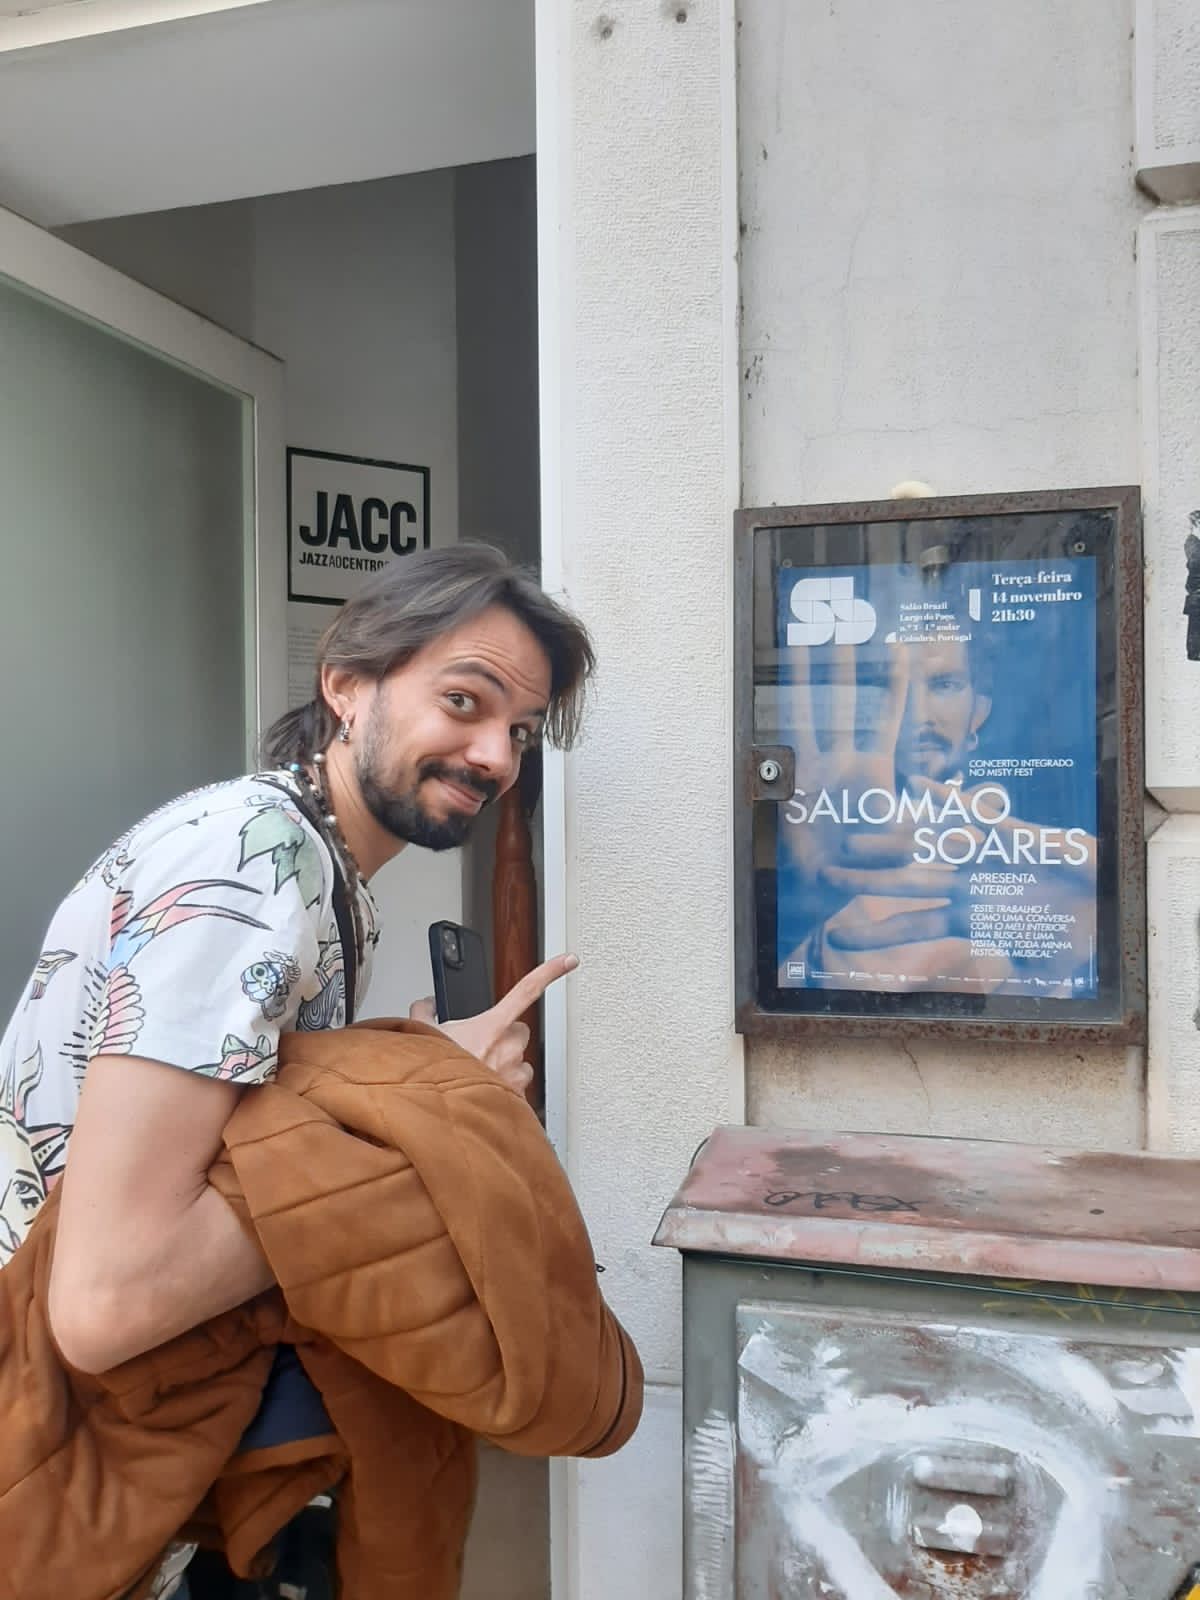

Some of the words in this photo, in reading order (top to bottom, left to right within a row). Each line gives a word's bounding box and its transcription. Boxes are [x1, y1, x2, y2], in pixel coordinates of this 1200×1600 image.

[299, 491, 416, 555] JACC
[992, 571, 1072, 587] Terça-feira
[992, 591, 1008, 604] 14
[1010, 588, 1083, 603] novembro
[991, 608, 1036, 622] 21h30
[968, 759, 1019, 768] CONCERTO
[1020, 758, 1074, 768] INTEGRADO
[968, 768, 985, 777] NO
[986, 768, 1013, 777] MISTY
[1014, 767, 1034, 776] FEST
[785, 779, 1011, 825] SALOMÃO
[912, 827, 1089, 866] SOARES
[969, 872, 1037, 884] APRESENTA
[970, 884, 1024, 896] INTERIOR
[995, 904, 1042, 914] TRABALHO
[970, 913, 1000, 922] COMO
[1002, 914, 1024, 922] UMA
[1026, 914, 1077, 923] CONVERSA
[970, 922, 993, 931] COM
[994, 922, 1004, 931] O
[1005, 922, 1025, 931] MEU
[970, 931, 992, 940] UMA
[993, 931, 1023, 940] BUSCA
[1033, 932, 1055, 940] UMA
